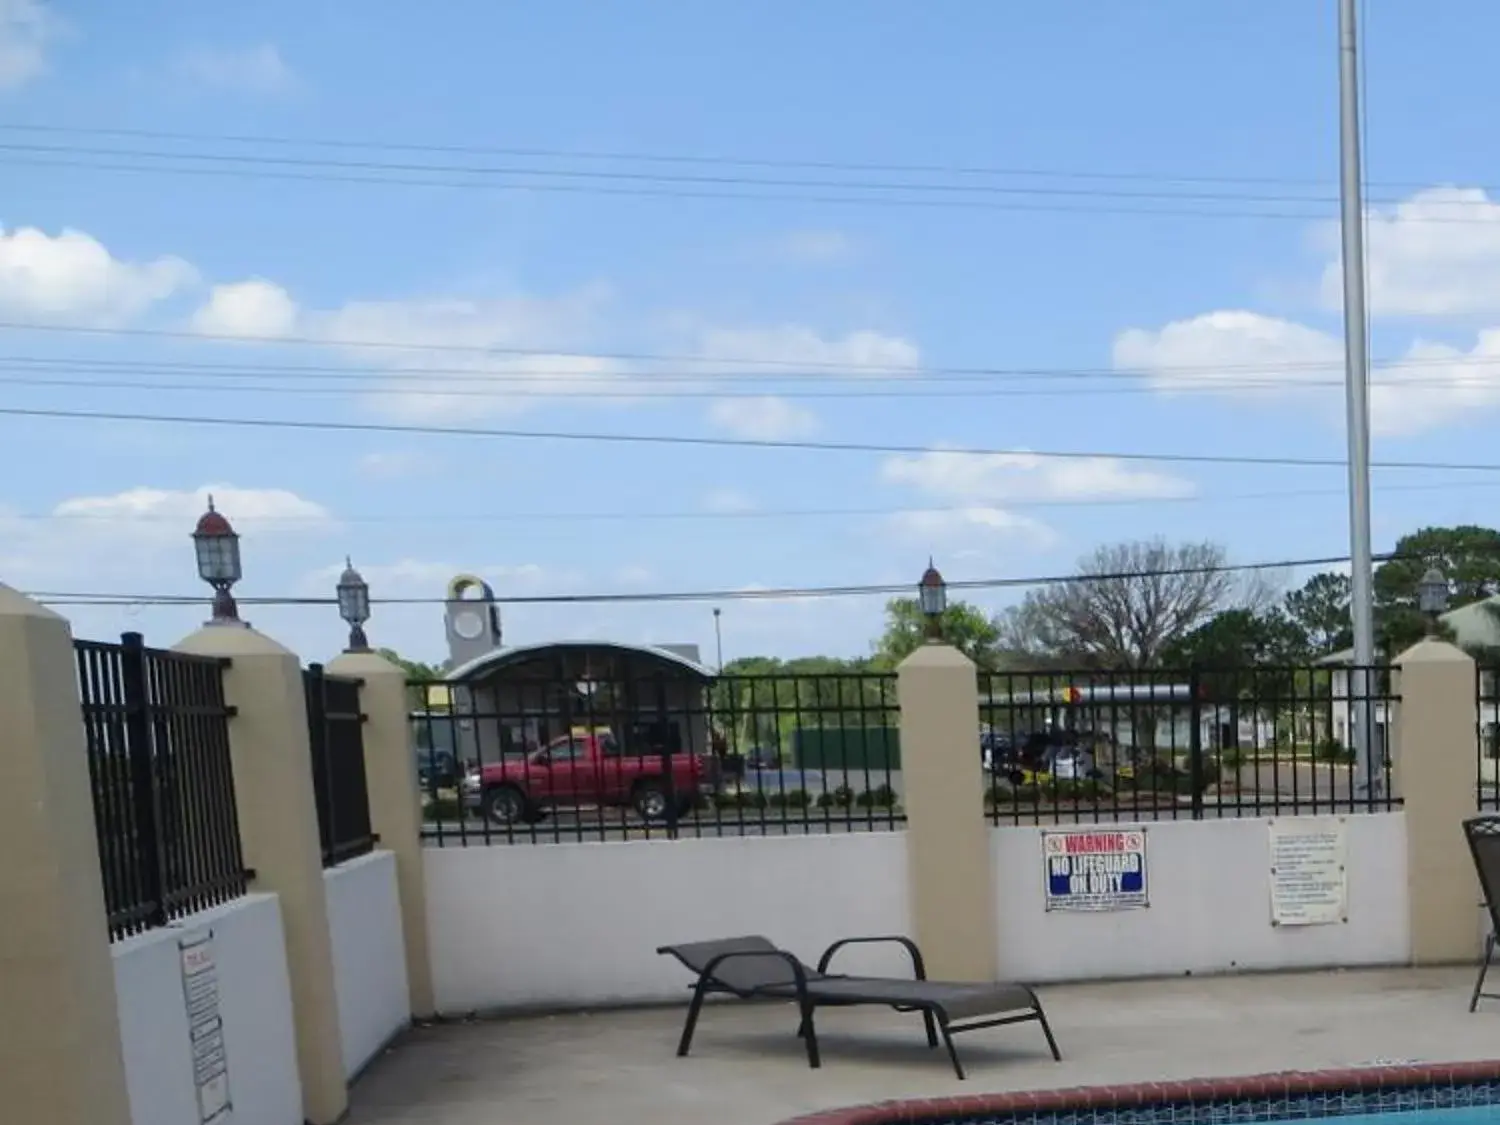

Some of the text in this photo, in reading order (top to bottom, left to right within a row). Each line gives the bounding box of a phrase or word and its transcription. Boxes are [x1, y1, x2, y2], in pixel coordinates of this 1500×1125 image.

[1066, 834, 1124, 852] WARNING
[1052, 854, 1138, 875] NO LIFEGUARD
[1070, 873, 1122, 893] ON DUTY
